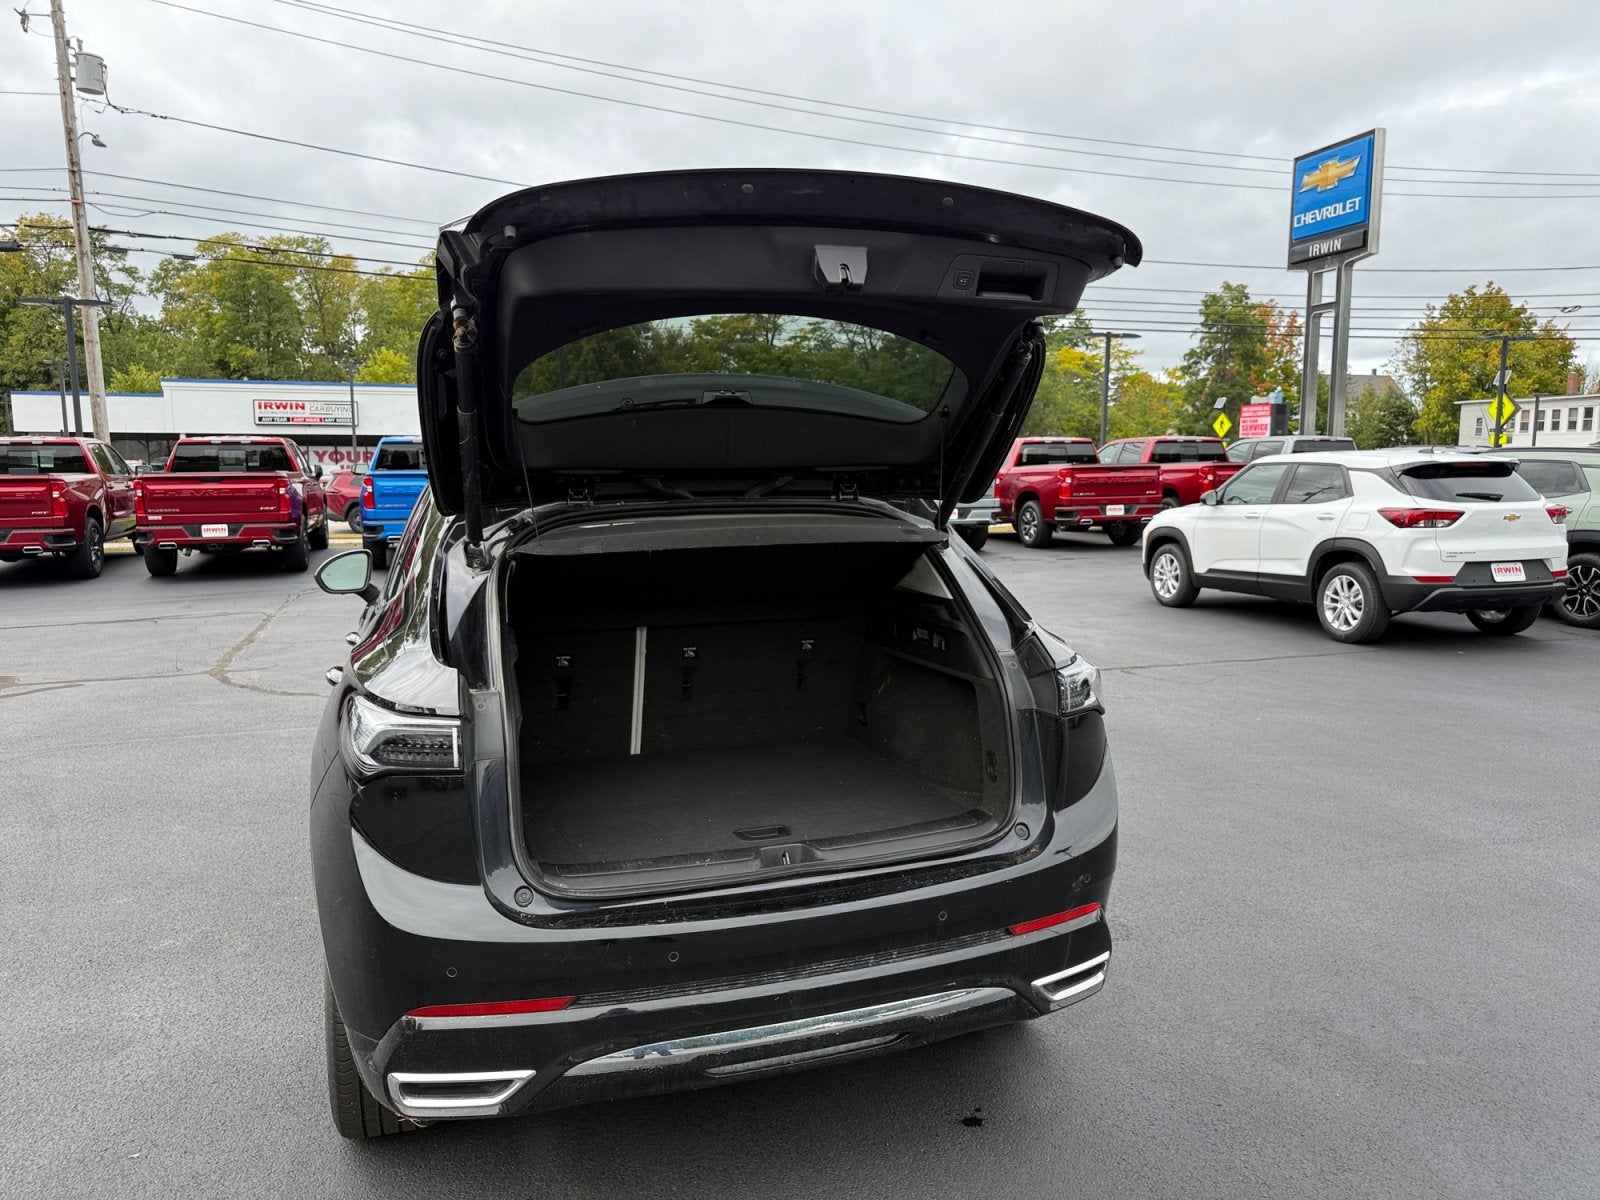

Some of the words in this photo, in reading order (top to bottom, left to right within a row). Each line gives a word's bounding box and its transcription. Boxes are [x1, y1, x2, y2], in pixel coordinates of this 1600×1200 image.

[1294, 197, 1362, 227] CHEVROLET
[1309, 238, 1341, 257] IRWIN
[258, 402, 305, 410] IRWIN
[312, 450, 374, 463] YOUR
[1494, 566, 1521, 575] IRWIN
